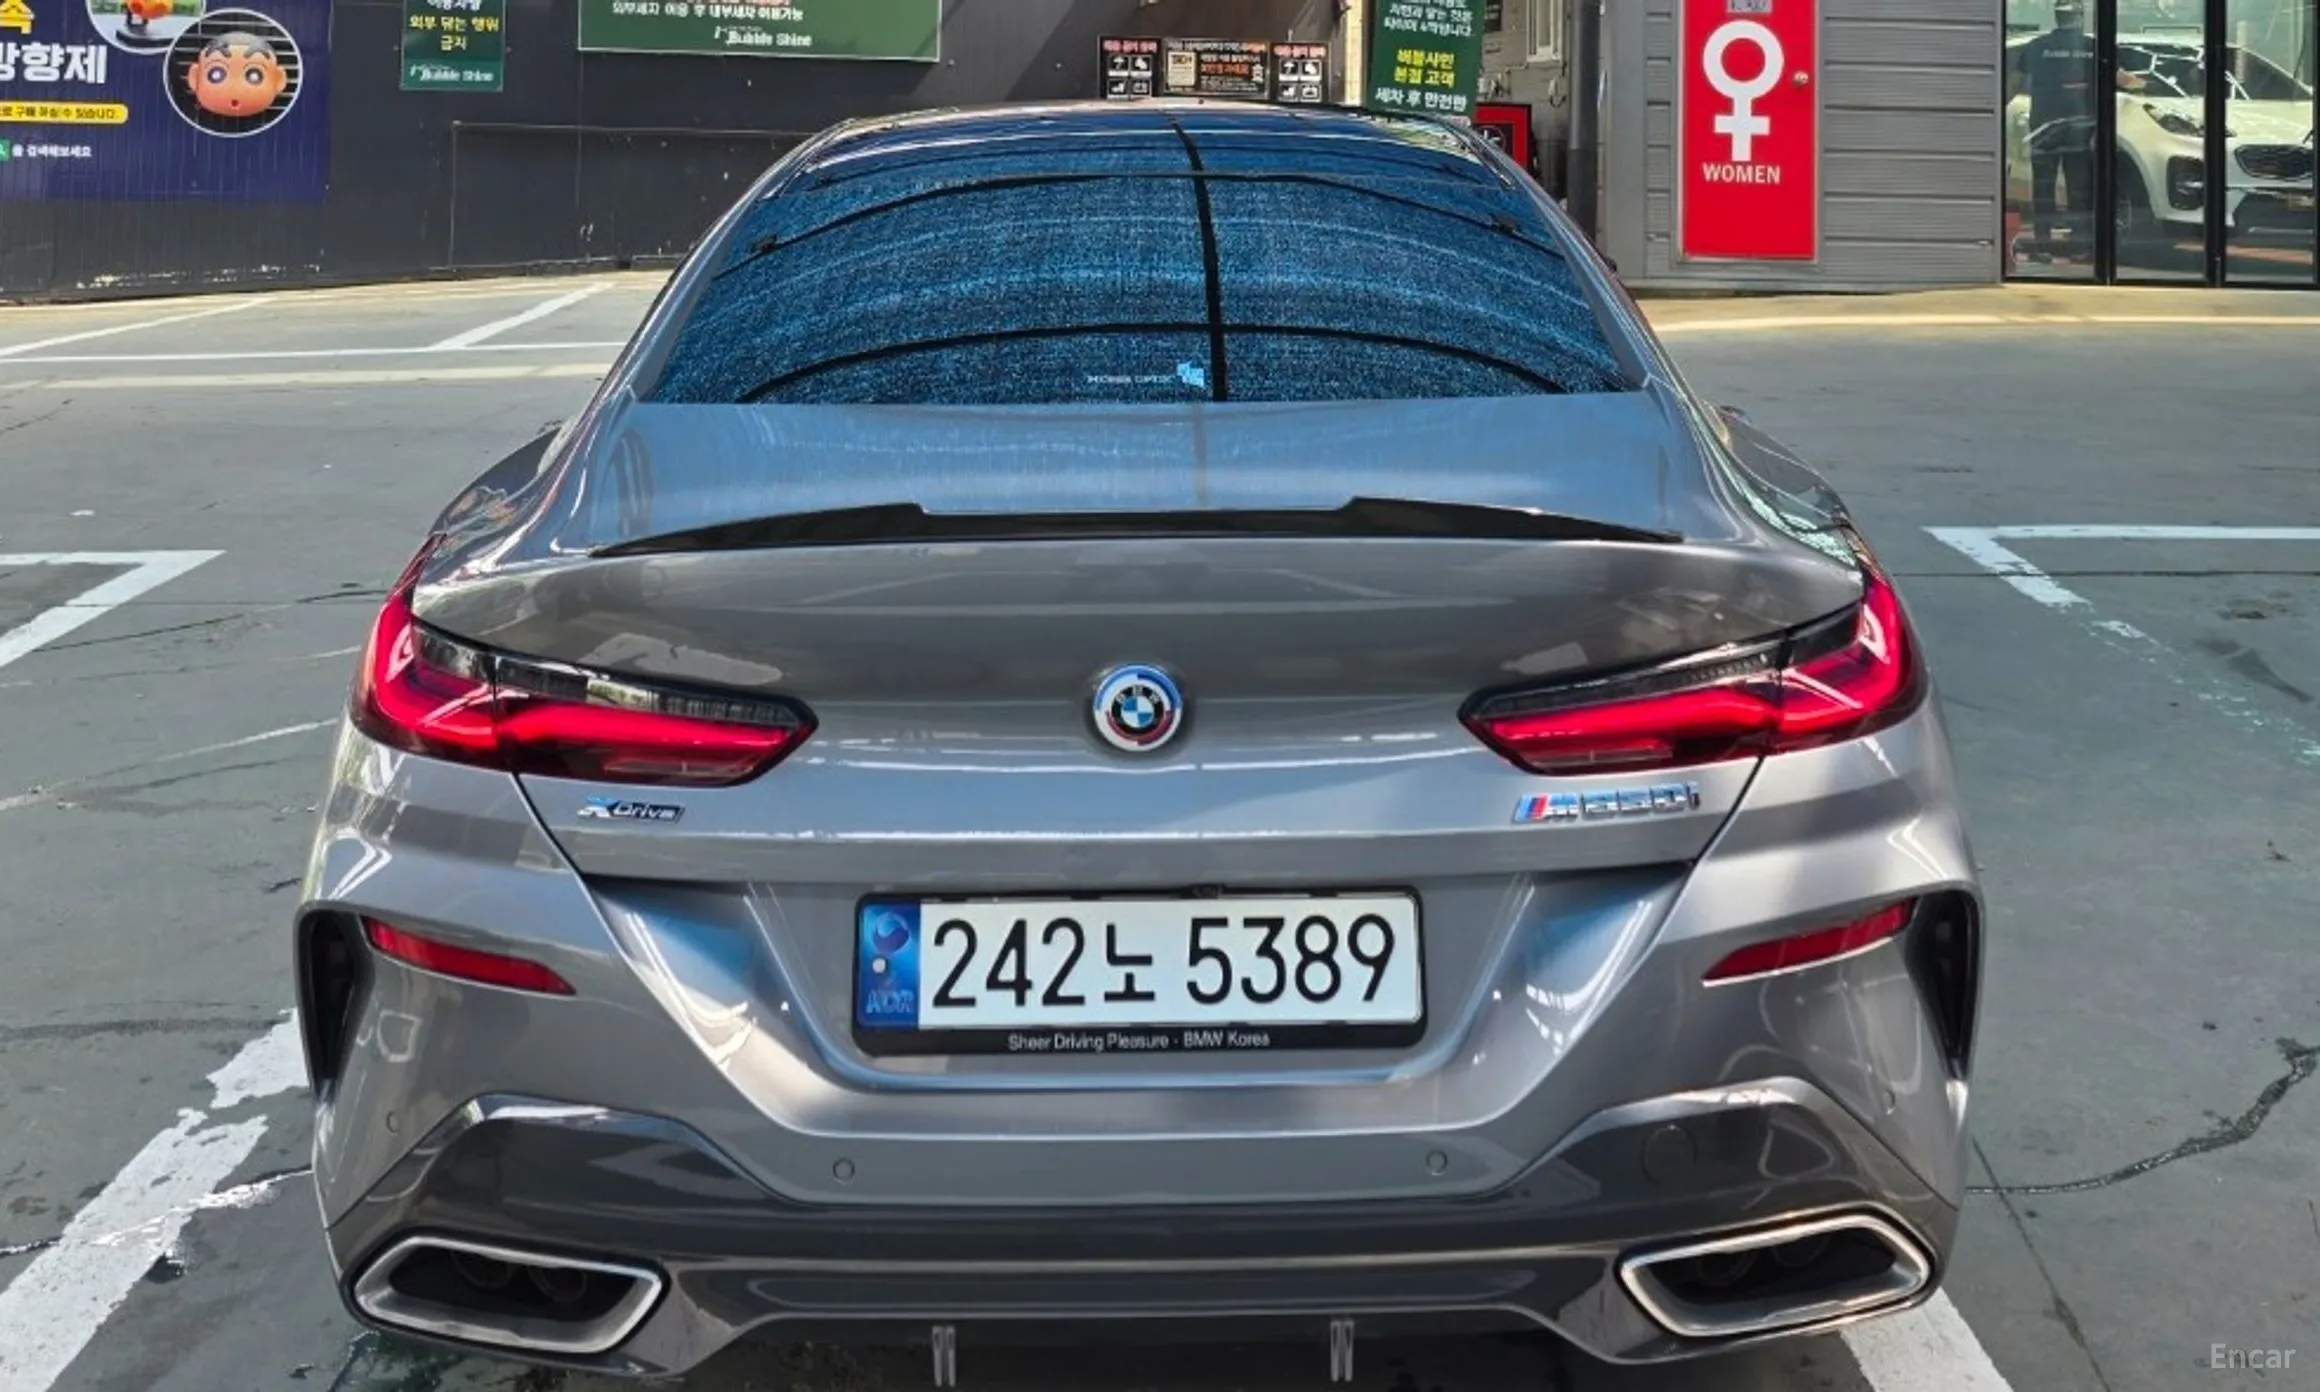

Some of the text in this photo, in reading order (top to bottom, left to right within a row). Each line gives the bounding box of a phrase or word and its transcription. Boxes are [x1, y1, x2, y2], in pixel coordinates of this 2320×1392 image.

[440, 35, 467, 51] 금지
[776, 33, 812, 46] Shine
[1375, 87, 1404, 105] 세차
[1406, 89, 1421, 107] 후
[1702, 162, 1780, 184] WOMEN
[932, 913, 1395, 1007] 242노 5389
[1008, 1031, 1270, 1052] Sheer Driving Pleasure BMW Korea
